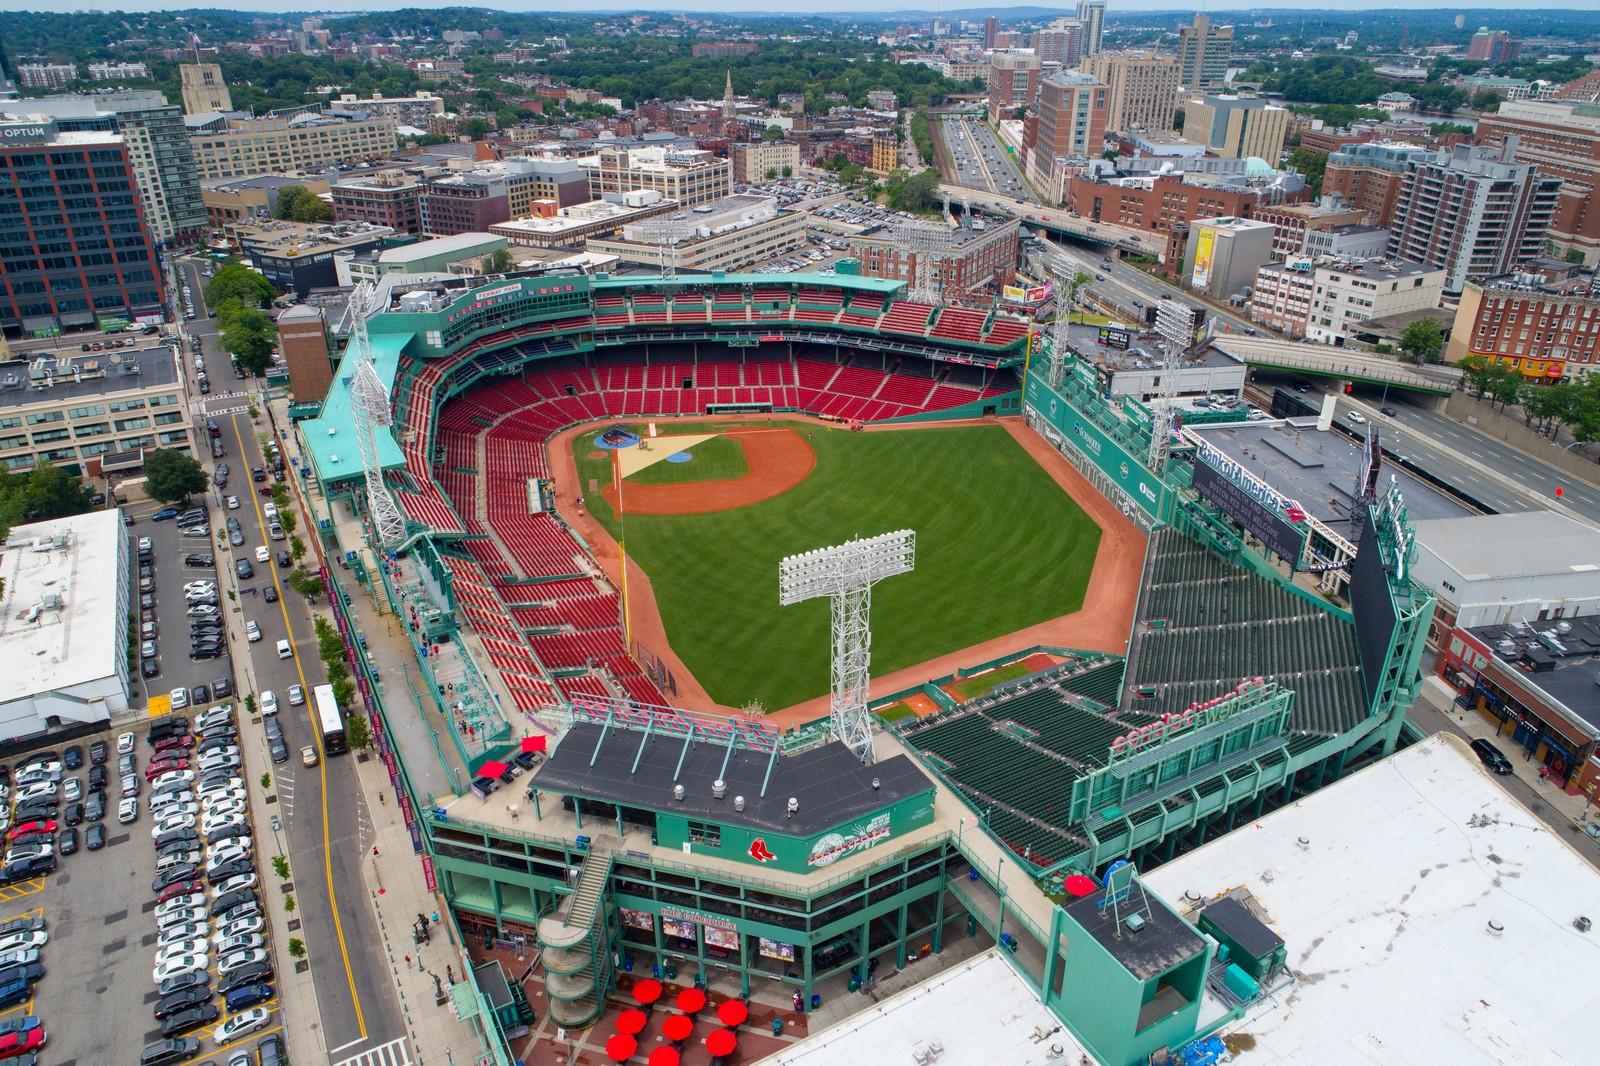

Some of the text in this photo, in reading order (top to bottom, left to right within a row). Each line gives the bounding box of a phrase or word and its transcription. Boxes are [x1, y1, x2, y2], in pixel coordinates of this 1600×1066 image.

[4, 127, 45, 138] OPTUM
[1235, 465, 1280, 513] America
[1269, 539, 1295, 562] LEAGUE
[667, 906, 699, 915] WELCOME
